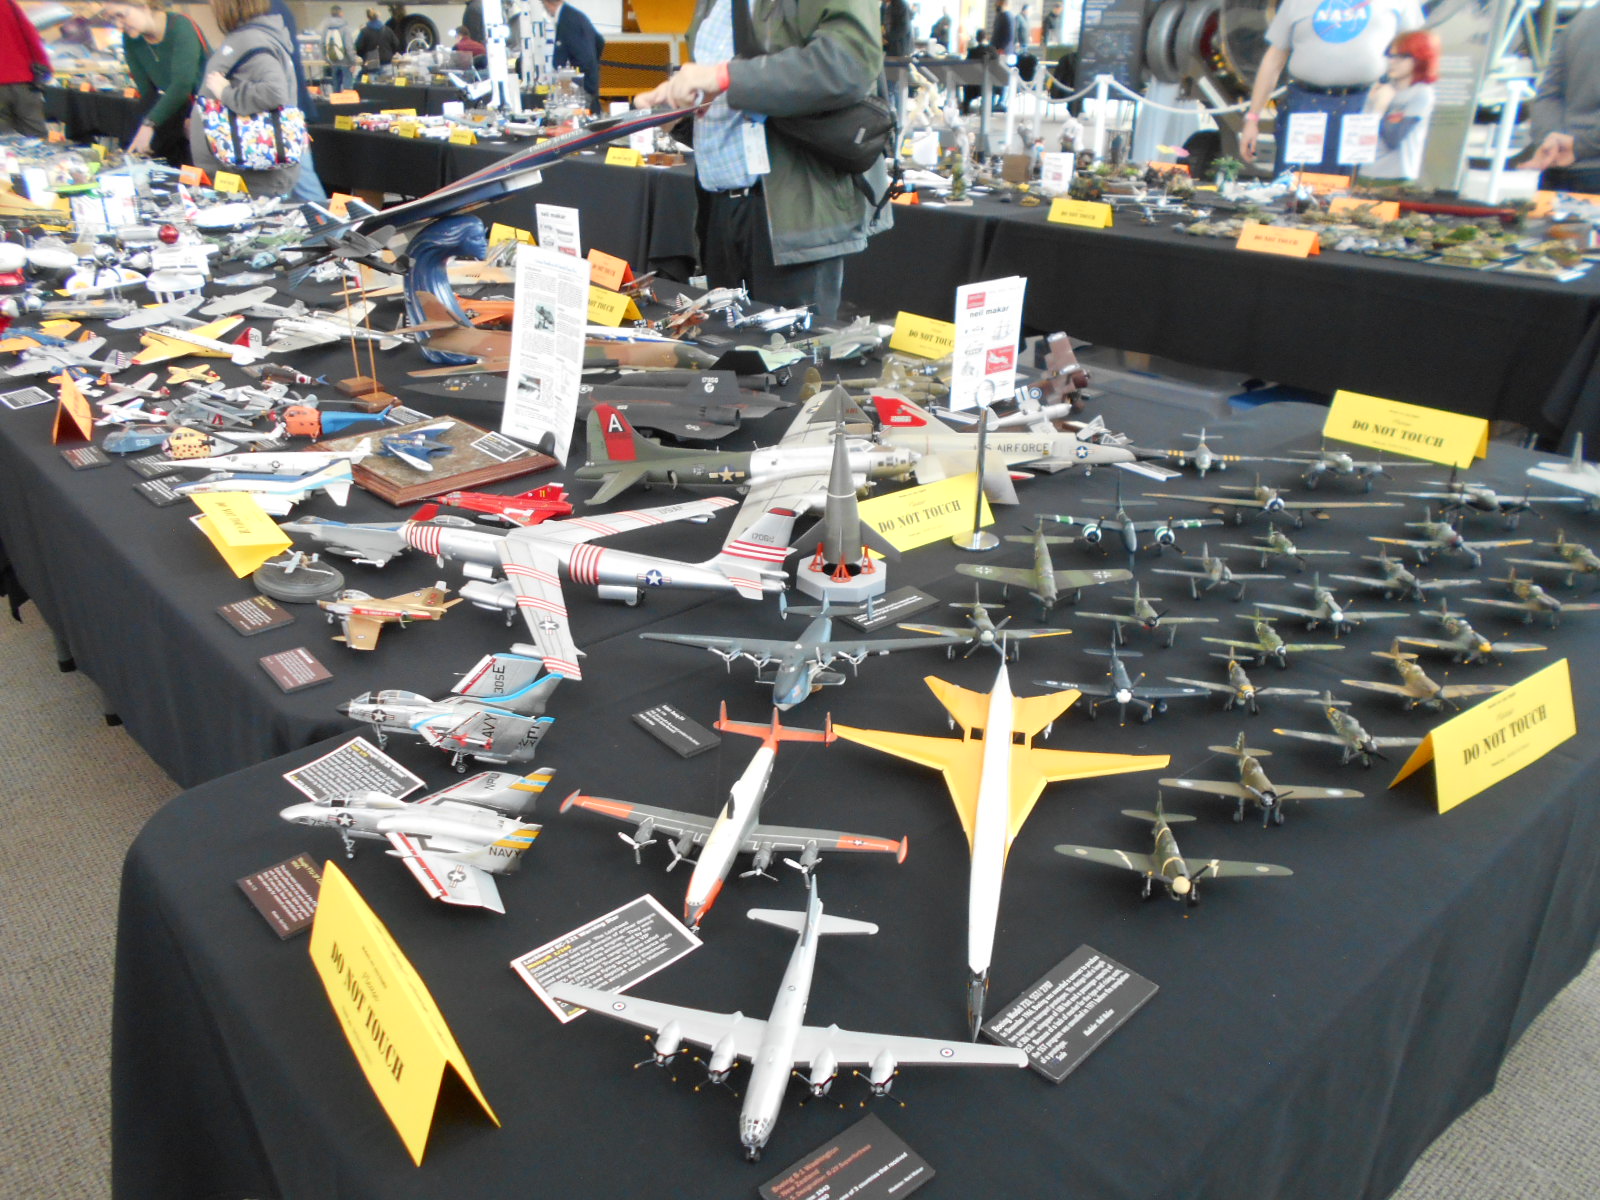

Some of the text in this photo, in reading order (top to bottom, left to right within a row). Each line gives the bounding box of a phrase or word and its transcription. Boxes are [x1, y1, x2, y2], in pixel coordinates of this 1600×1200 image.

[1315, 9, 1368, 23] NASA
[935, 335, 954, 347] TOUC
[608, 413, 623, 433] A
[1352, 419, 1445, 448] DO NOT TOUCH
[878, 500, 962, 533] DO NOT TOUCH
[1462, 744, 1480, 766] DO
[1483, 728, 1507, 755] NOT
[1508, 704, 1548, 738] TOUCH
[489, 845, 523, 857] NAVY
[331, 940, 345, 975] DO
[344, 967, 366, 1012] NOT
[365, 1005, 404, 1083] TOUCH
[991, 1017, 1013, 1033] Boeing
[1006, 1005, 1025, 1020] Model
